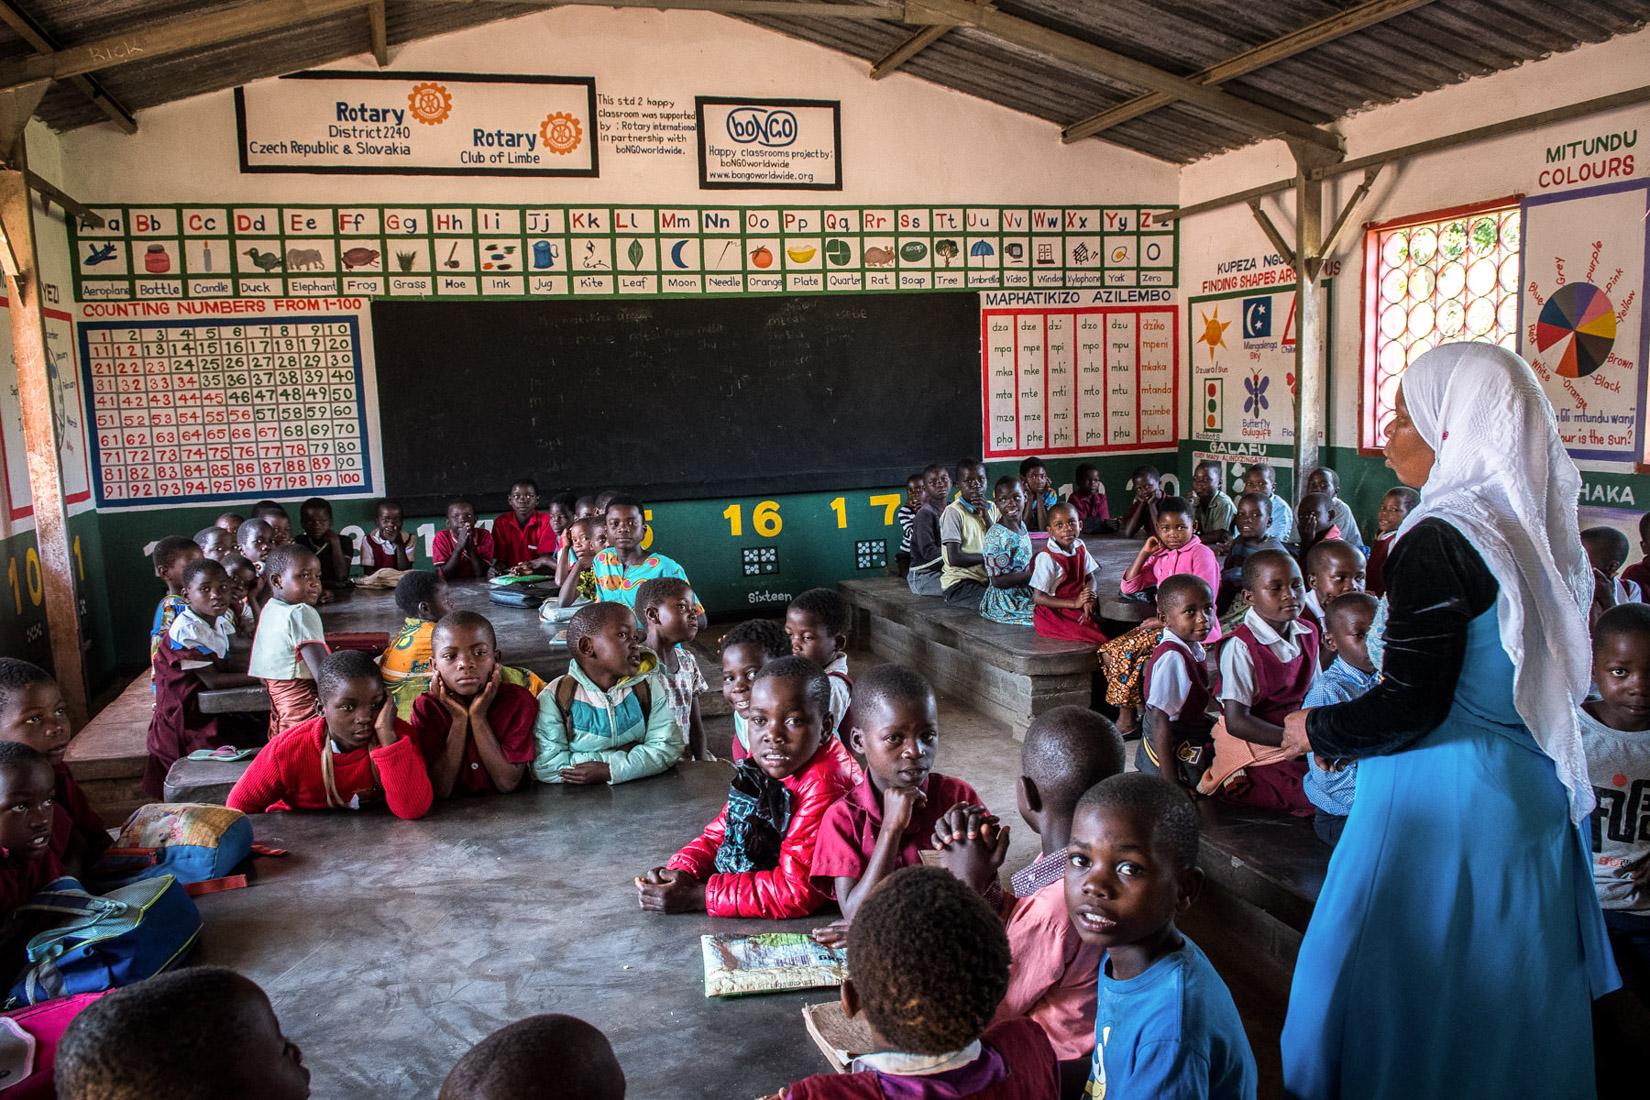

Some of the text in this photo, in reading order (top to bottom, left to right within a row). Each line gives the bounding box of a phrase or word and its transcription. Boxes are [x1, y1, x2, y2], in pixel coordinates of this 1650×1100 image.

[598, 94, 674, 108] This std 2 happy
[336, 102, 404, 126] Rotary
[660, 110, 696, 121] supported
[622, 122, 650, 132] Rotary
[653, 122, 696, 131] international
[473, 128, 538, 151] Rotary
[600, 133, 686, 144] in partnership with
[250, 140, 410, 157] Czech Republic & Slovakia
[709, 146, 736, 158] Happy
[741, 149, 790, 158] classrooms
[1546, 130, 1638, 164] MITUNDU
[460, 150, 540, 164] Club of Limbe
[710, 171, 814, 182] www.bongoworldwide.org
[1538, 154, 1635, 188] COLOURS
[1217, 258, 1256, 275] KUPEZA
[1554, 256, 1566, 284] Grey
[709, 278, 740, 286] Needle
[794, 278, 818, 286] Plate
[830, 276, 862, 286] Quarter
[872, 276, 890, 285] Rat
[902, 276, 925, 286] Soap
[937, 276, 958, 284] Tree
[968, 276, 1000, 284] Umbrella
[1006, 275, 1027, 284] Video
[1067, 275, 1100, 286] Xylophone
[1142, 274, 1162, 282] Zero
[1202, 277, 1238, 293] FINDING
[1240, 270, 1276, 289] SHAPES
[1325, 260, 1341, 277] US
[194, 282, 228, 294] Candle
[242, 282, 270, 292] Duck
[292, 282, 337, 293] Elephant
[348, 281, 376, 292] Frog
[394, 280, 426, 290] Grass
[446, 280, 466, 288] Hoe
[492, 280, 510, 288] Ink
[534, 279, 552, 291] Jug
[580, 277, 603, 288] Kite
[622, 277, 648, 288] Leaf
[668, 278, 696, 287] Moon
[750, 278, 782, 290] Orange
[84, 285, 130, 298] Aeroplane
[140, 284, 180, 296] Bottle
[1528, 282, 1544, 306] Blue
[986, 290, 1170, 306] MAPHATIKIZO AZILEMBO
[83, 298, 362, 317] COUNTING NUMBERS FROM 1-100
[1616, 290, 1636, 322] Yellow
[328, 324, 347, 335] 10
[993, 322, 1008, 331] dza
[1021, 321, 1036, 330] dze
[1049, 320, 1062, 330] dzi
[1082, 319, 1097, 329] dzo
[1112, 320, 1128, 328] dzu
[1143, 319, 1165, 330] dziko
[1528, 324, 1538, 345] Red
[172, 344, 194, 354] 14
[1143, 338, 1168, 349] mpeni
[995, 346, 1011, 357] mpa
[174, 360, 195, 370] 24
[201, 359, 220, 370] 25
[252, 357, 271, 368] 27
[1142, 362, 1166, 371] mkaka
[1607, 352, 1634, 370] Brown
[1532, 358, 1550, 382] White
[150, 378, 169, 389] 33
[202, 375, 220, 387] 35
[1594, 374, 1621, 394] Black
[332, 388, 352, 399] 50
[1142, 383, 1171, 393] mtanda
[229, 392, 250, 403] 46
[1563, 379, 1588, 410] Orange
[256, 409, 276, 420] 57
[1142, 406, 1170, 415] mzimbe
[1574, 408, 1608, 424] mtundu
[1242, 419, 1270, 429] Butterfly
[284, 425, 304, 436] 68
[1142, 425, 1165, 438] phala
[1242, 428, 1271, 440] Gulugufe
[1578, 428, 1586, 444] is
[1589, 429, 1604, 444] the
[997, 432, 1012, 446] pha
[310, 443, 329, 453] 79
[1210, 442, 1266, 456] GALAFU
[130, 467, 149, 479] 82
[339, 473, 360, 484] 100
[315, 474, 332, 486] 99
[105, 485, 123, 498] 91
[723, 501, 782, 537] 16
[8, 548, 42, 615] 10
[748, 590, 792, 604] Sixteen
